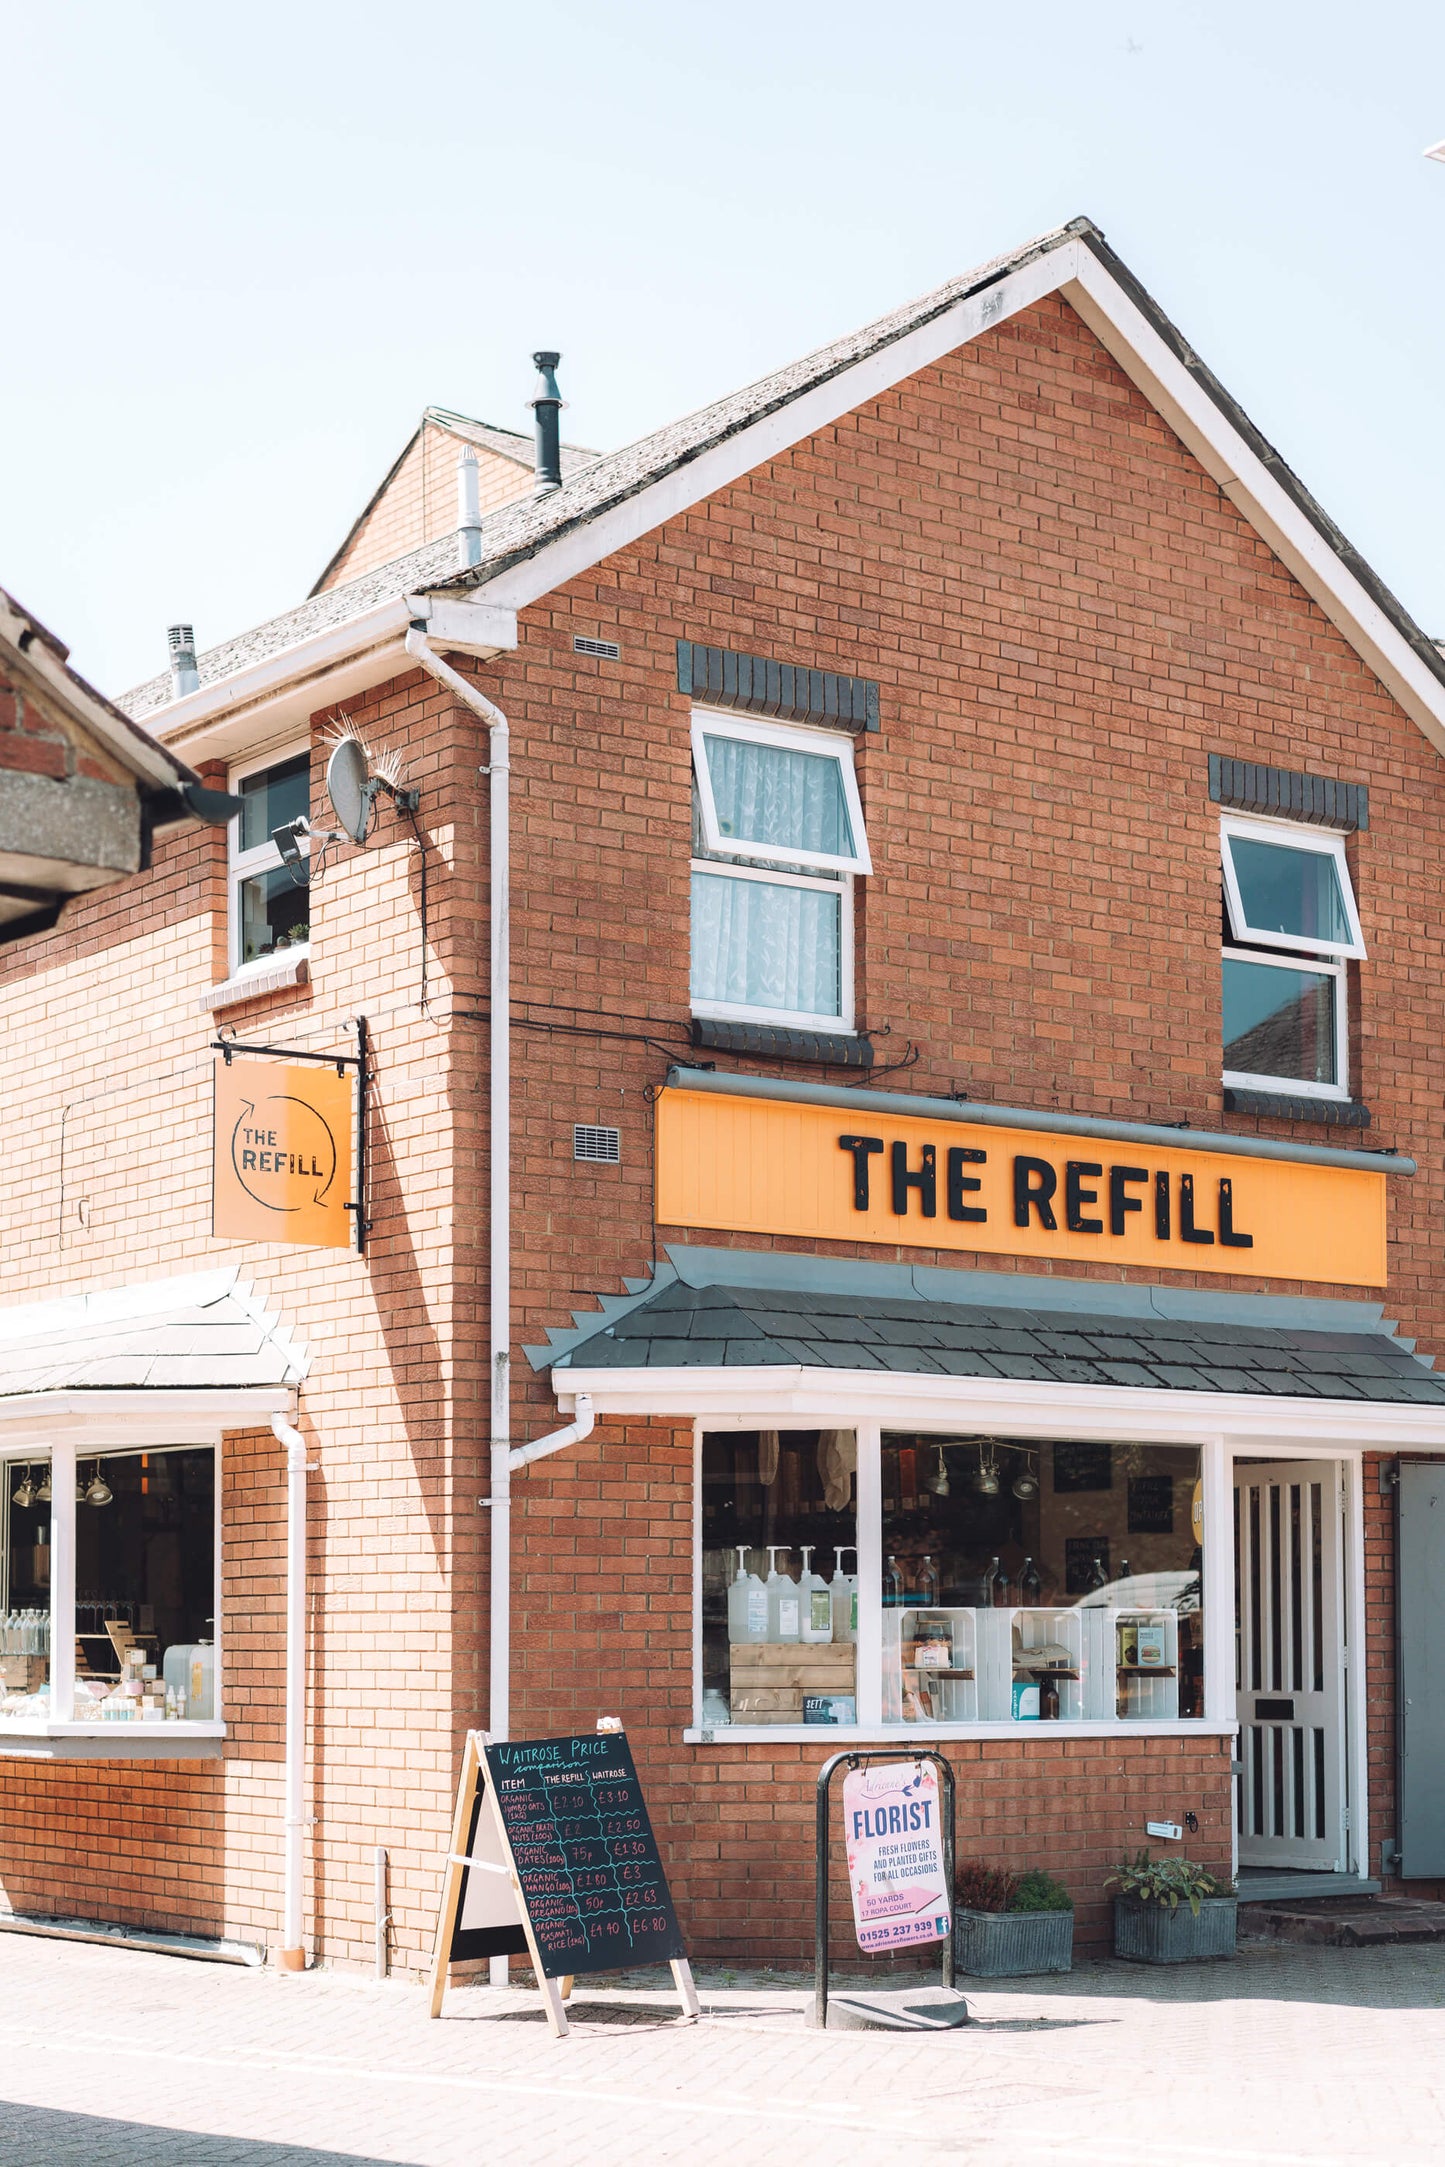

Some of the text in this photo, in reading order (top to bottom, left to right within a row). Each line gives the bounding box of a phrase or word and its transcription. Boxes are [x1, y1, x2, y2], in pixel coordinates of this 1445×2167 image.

[243, 1128, 278, 1146] THE
[242, 1149, 324, 1176] REFILL
[839, 1135, 1254, 1248] THE REFILL
[1194, 1502, 1202, 1524] OP
[500, 1740, 609, 1764] WAITROSE PRICE
[514, 1760, 590, 1774] comparison
[545, 1772, 584, 1784] THE REFILL
[592, 1768, 627, 1780] WAITROSE
[502, 1778, 526, 1790] ITEM
[500, 1794, 532, 1804] ORGANIC
[504, 1802, 546, 1813] JUMBO OATS
[853, 1800, 932, 1840] FLORIST
[508, 1825, 535, 1834] ORGANIC
[512, 1832, 530, 1842] NUTS
[514, 1846, 548, 1856] ORGANIC
[879, 1839, 930, 1856] FRESH FLOWERS
[518, 1855, 546, 1864] DATES
[572, 1847, 592, 1862] 75p
[874, 1850, 937, 1870] AND PLANTED GIFTS
[522, 1873, 559, 1884] ORGANIC
[624, 1865, 642, 1880] £3
[874, 1862, 938, 1882] FOR ALL OCCASIONS
[526, 1882, 554, 1892] MANGO
[530, 1898, 564, 1909] ORGANIC
[586, 1896, 604, 1910] 50p
[866, 1894, 904, 1907] 50 YARDS
[530, 1906, 566, 1918] OREGANO
[862, 1902, 912, 1918] 17 ROPA COURT
[536, 1921, 567, 1932] ORGANIC
[860, 1920, 932, 1942] 01525 237 939
[541, 1929, 572, 1943] BASMATI
[548, 1940, 566, 1951] RICE
